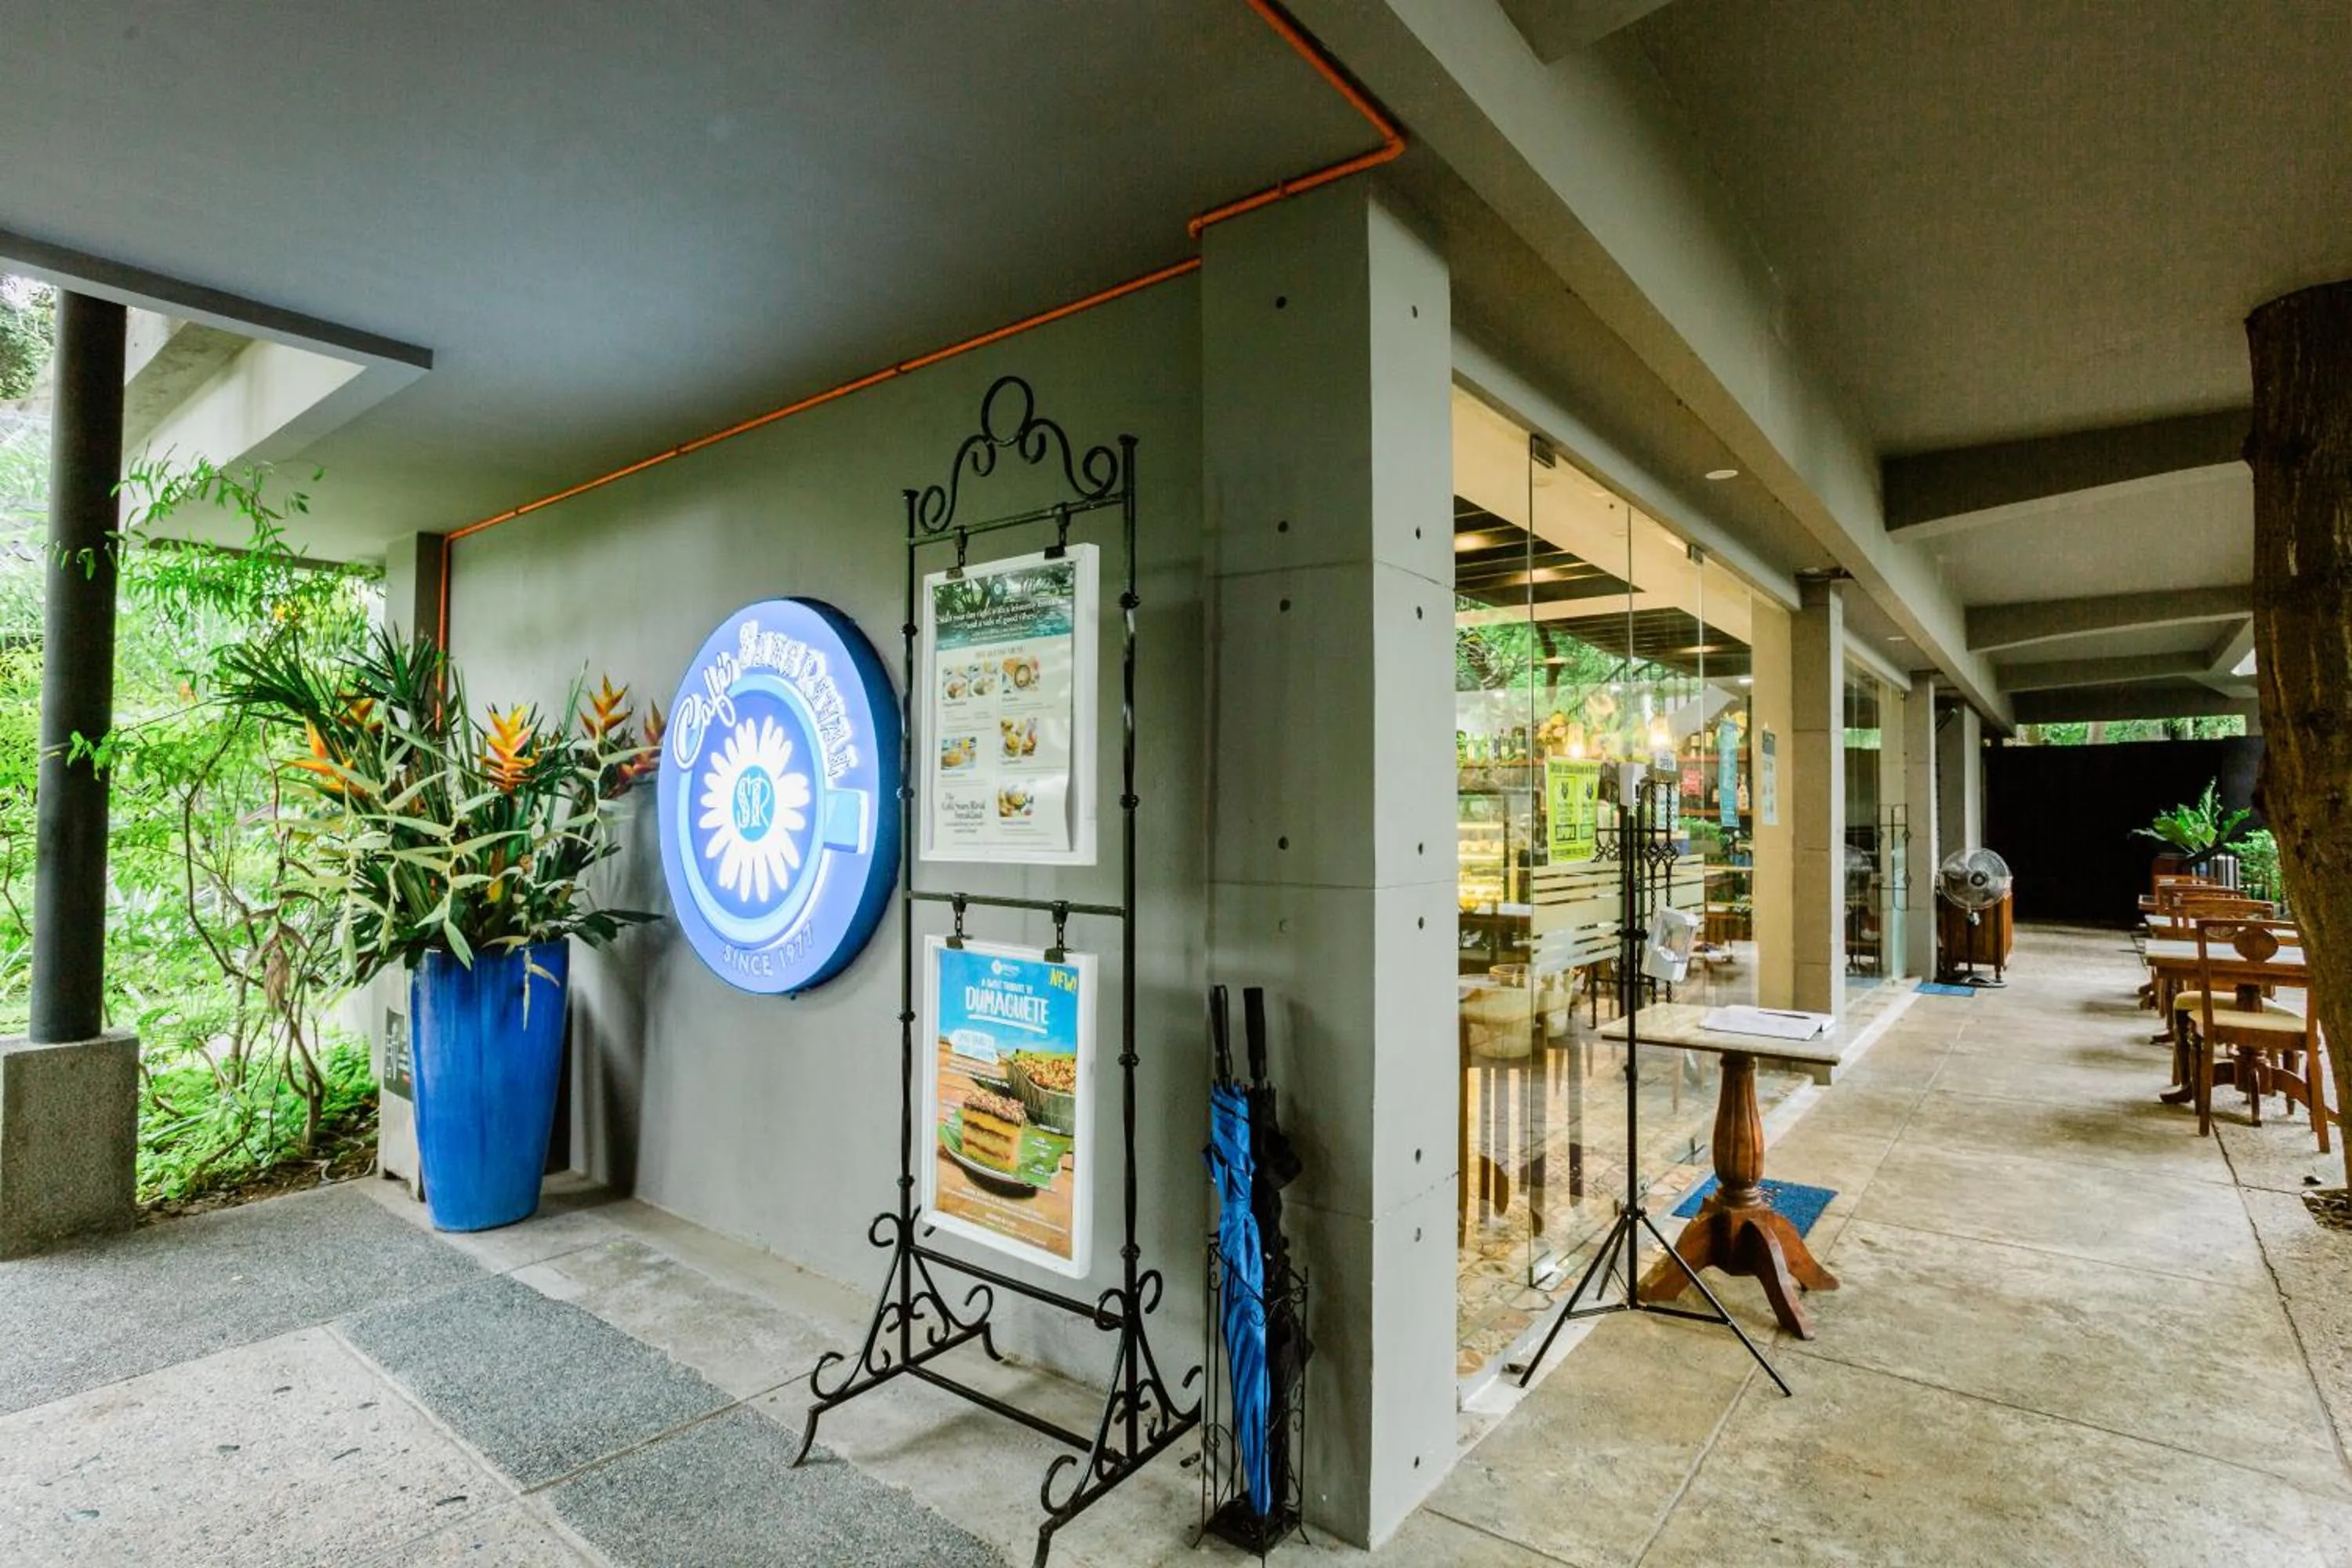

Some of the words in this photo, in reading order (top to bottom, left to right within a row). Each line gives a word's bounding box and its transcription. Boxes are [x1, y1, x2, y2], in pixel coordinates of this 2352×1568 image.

[723, 943, 774, 978] SINCE
[777, 920, 815, 969] 1977
[965, 985, 1050, 1026] DUMAGUETE
